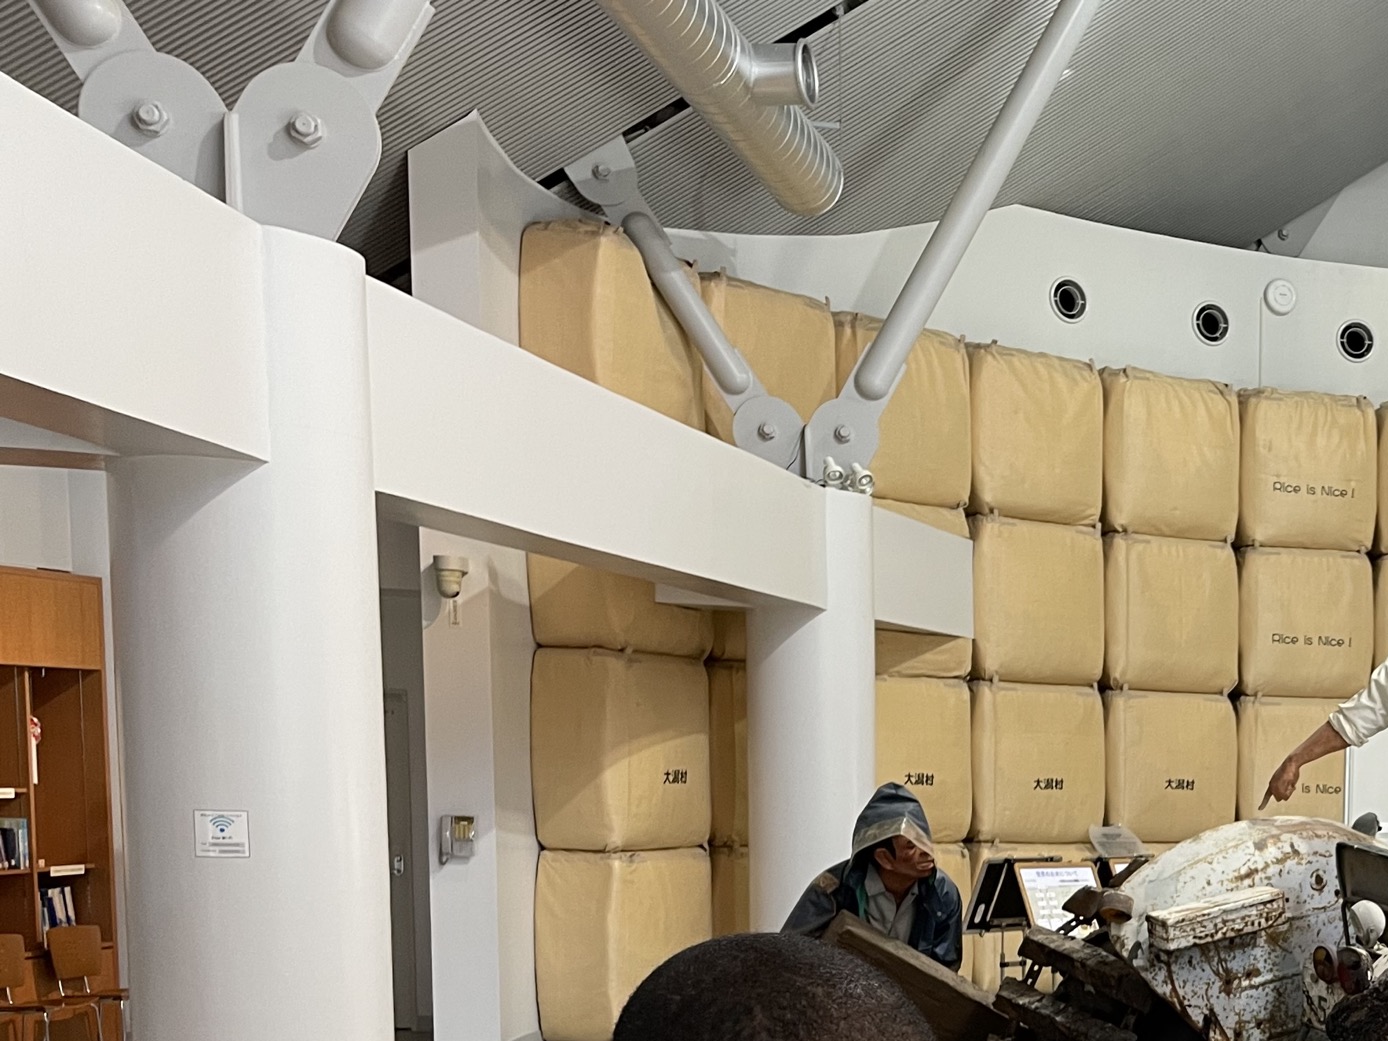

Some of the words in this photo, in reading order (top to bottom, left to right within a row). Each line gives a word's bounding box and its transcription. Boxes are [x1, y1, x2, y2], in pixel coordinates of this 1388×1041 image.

[1272, 481, 1301, 494] Rice
[1306, 484, 1316, 496] is
[1321, 485, 1348, 499] Nice
[1271, 633, 1299, 645] Rice
[1303, 635, 1313, 646] is
[1317, 636, 1345, 648] Nice
[1301, 783, 1311, 793] is
[1315, 784, 1342, 794] Nice
